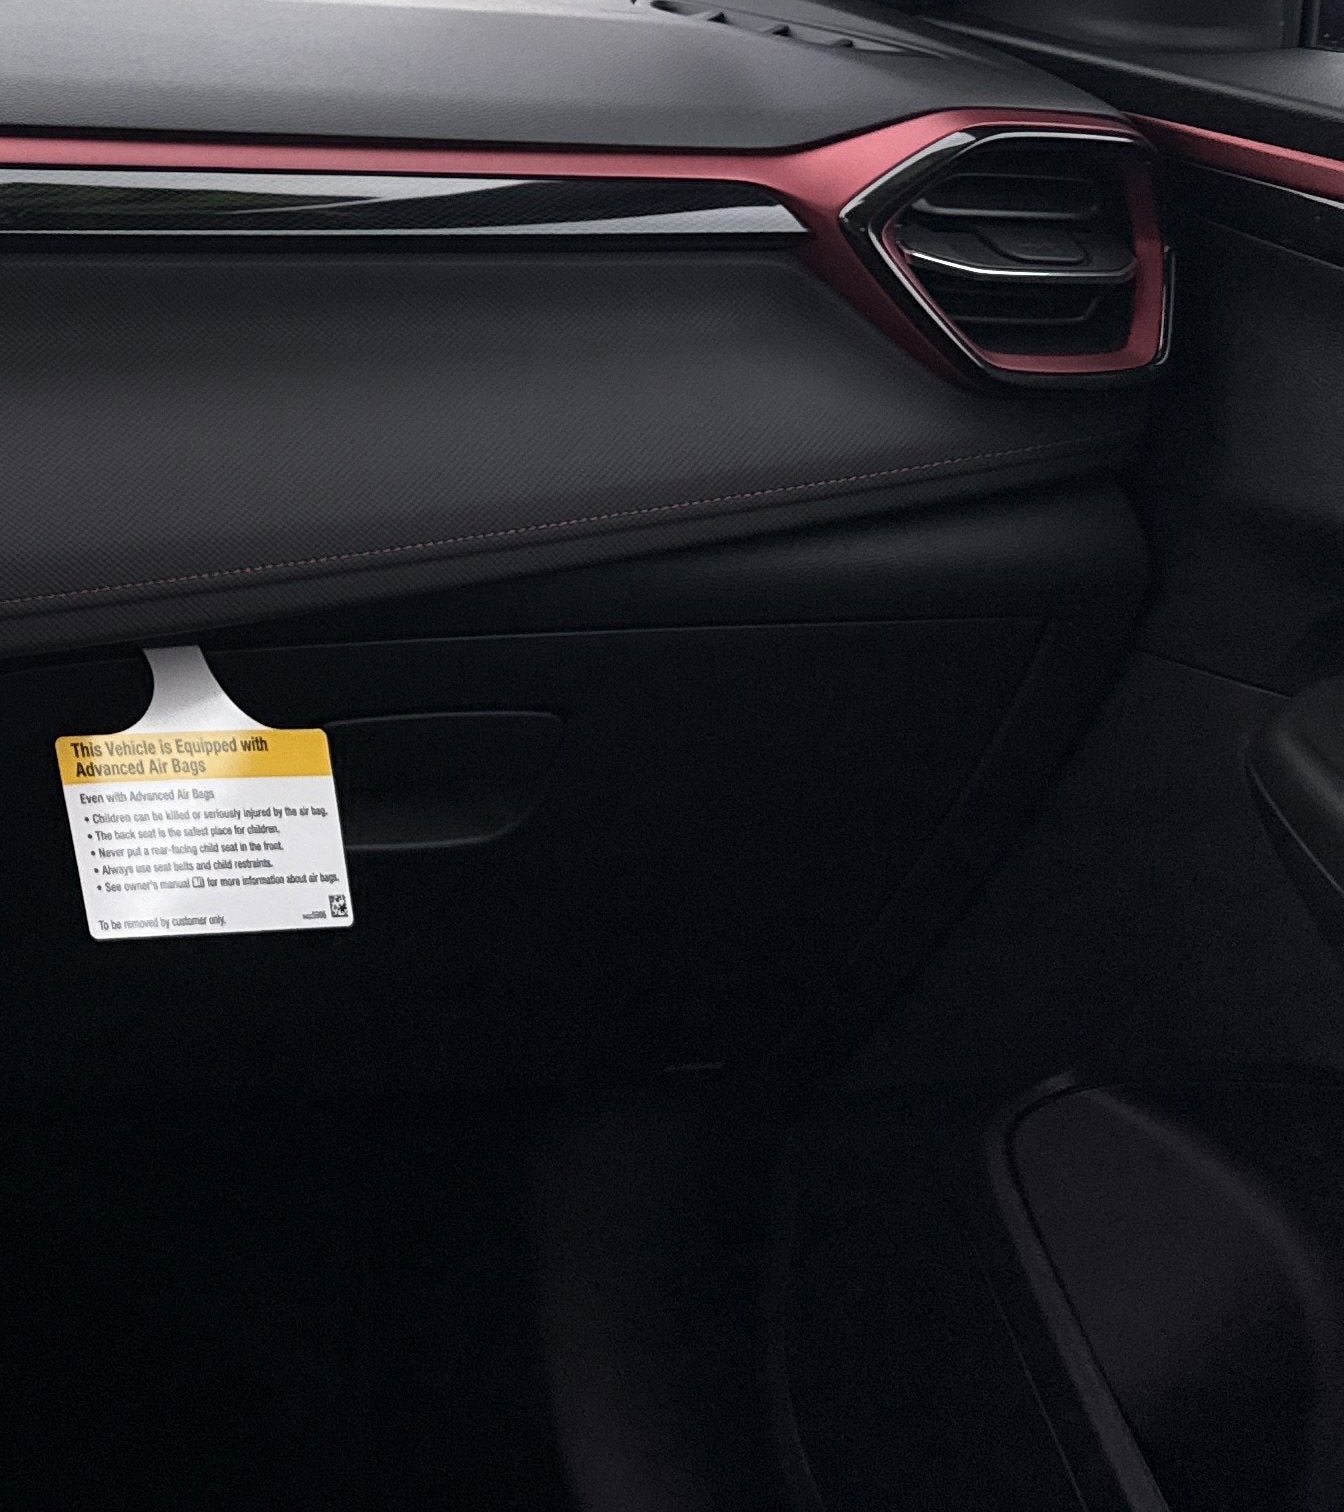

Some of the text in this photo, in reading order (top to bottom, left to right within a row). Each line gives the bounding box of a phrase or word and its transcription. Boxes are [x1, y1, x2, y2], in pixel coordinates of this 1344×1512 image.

[70, 736, 268, 759] This Vehicle is Equipped with
[76, 758, 206, 777] Advanced Air Bags
[79, 788, 214, 805] Even with Advanced Air Bags
[93, 812, 131, 825] Children
[133, 812, 150, 822] can
[152, 811, 163, 821] be
[165, 809, 190, 821] killed
[192, 810, 200, 820] or
[204, 807, 240, 820] seriously
[244, 807, 271, 819] injured
[273, 807, 283, 818] by
[284, 806, 297, 817] the
[299, 806, 309, 816] air
[95, 830, 112, 841] The
[114, 830, 136, 840] back
[138, 828, 156, 839] seat
[158, 828, 166, 838] is
[168, 828, 181, 838] the
[184, 826, 208, 837] safest
[211, 826, 232, 837] place
[234, 825, 245, 834] for
[98, 847, 124, 858] Never
[127, 846, 142, 858] put
[144, 847, 150, 856] a
[151, 844, 198, 856] rear-facing
[199, 843, 219, 854] child
[221, 843, 238, 853] seat
[240, 842, 247, 851] in
[249, 841, 261, 851] the
[102, 864, 134, 876] Always
[136, 865, 151, 874] use
[153, 862, 171, 873] seat
[173, 862, 193, 872] belts
[196, 860, 212, 870] and
[213, 859, 232, 870] child
[104, 882, 122, 892] See
[124, 880, 159, 891] owner's
[160, 878, 190, 889] manual
[207, 877, 218, 887] for
[220, 877, 240, 887] more
[242, 875, 285, 886] information
[286, 874, 307, 884] about
[309, 873, 318, 882] air
[98, 919, 109, 930] To
[111, 919, 122, 930] be
[123, 918, 159, 929] removed
[160, 917, 170, 929] by
[172, 916, 207, 927] customer
